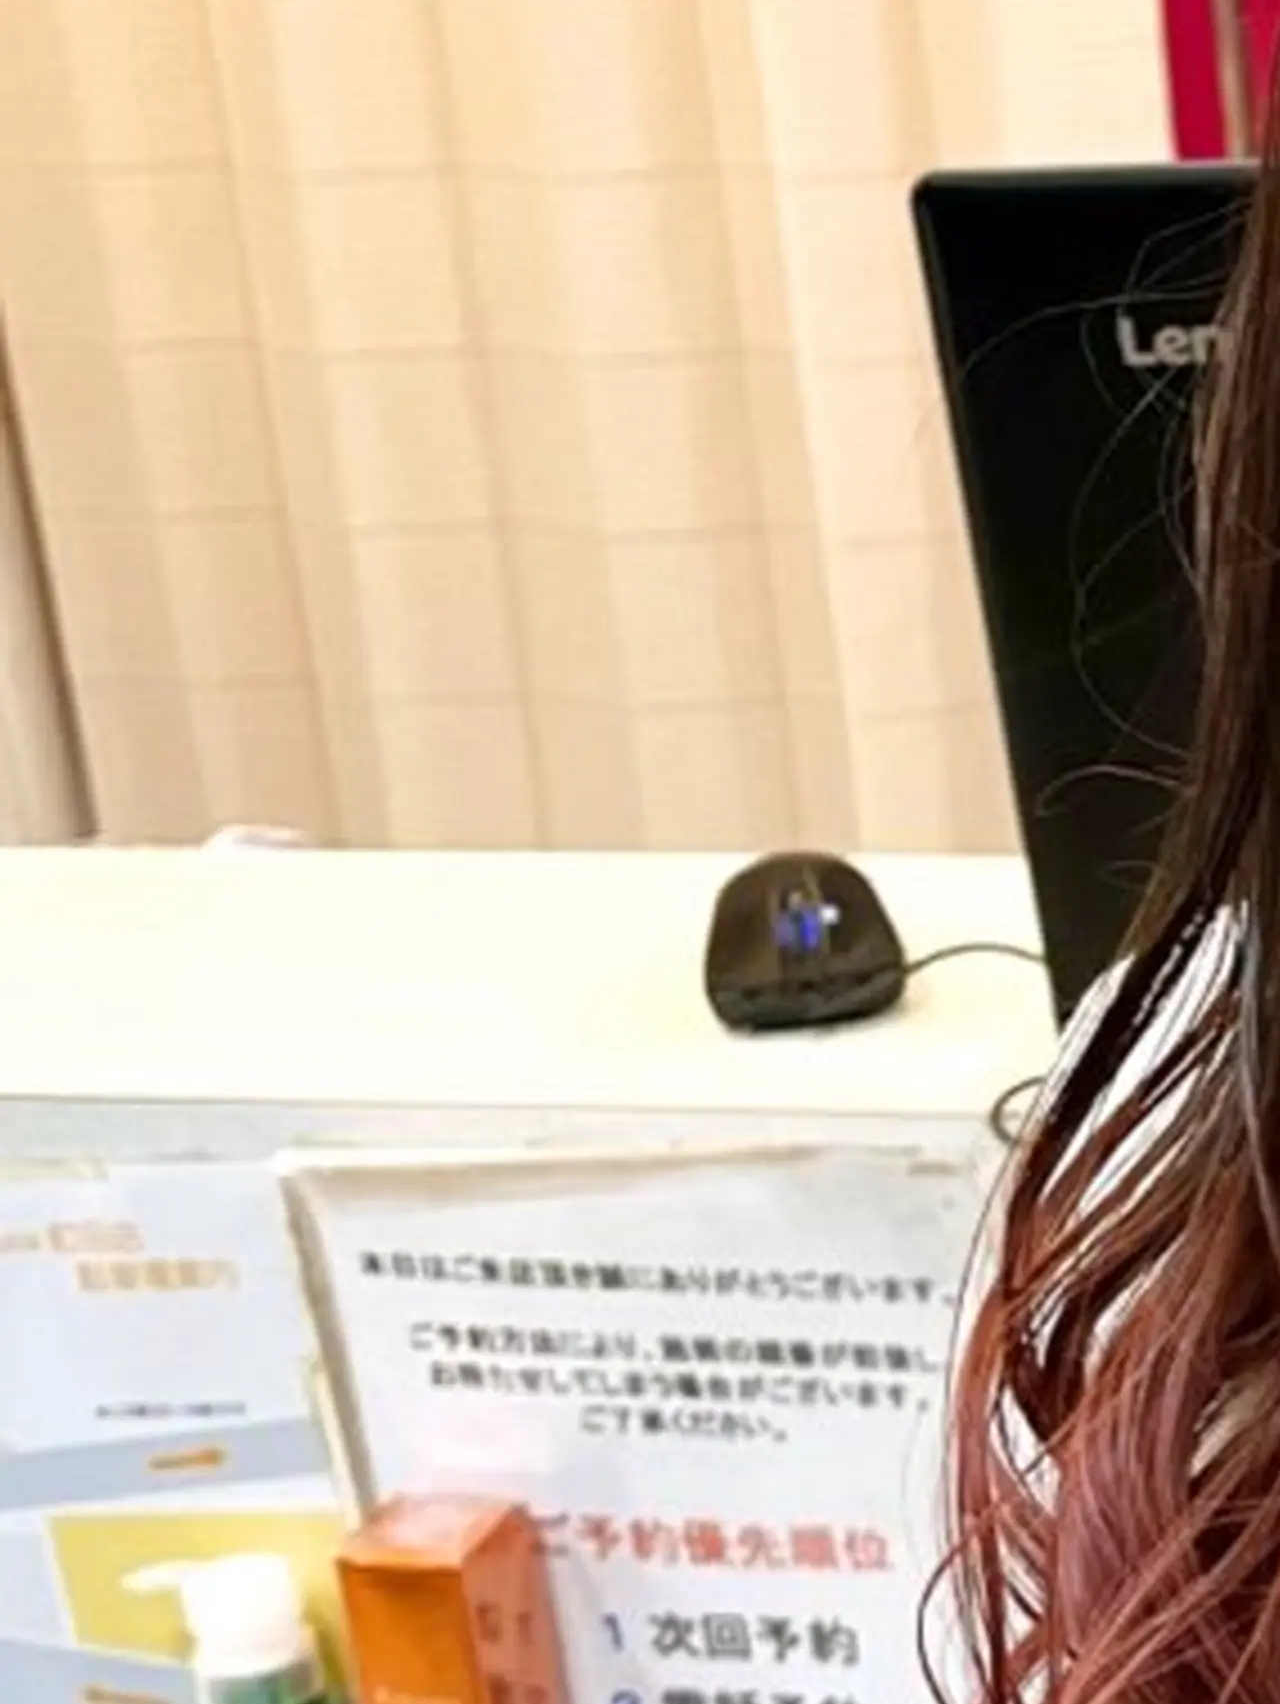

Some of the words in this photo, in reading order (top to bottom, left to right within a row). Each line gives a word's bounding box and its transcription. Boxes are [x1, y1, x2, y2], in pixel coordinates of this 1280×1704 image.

[603, 1612, 624, 1653] 1
[648, 1609, 861, 1666] 次回予約
